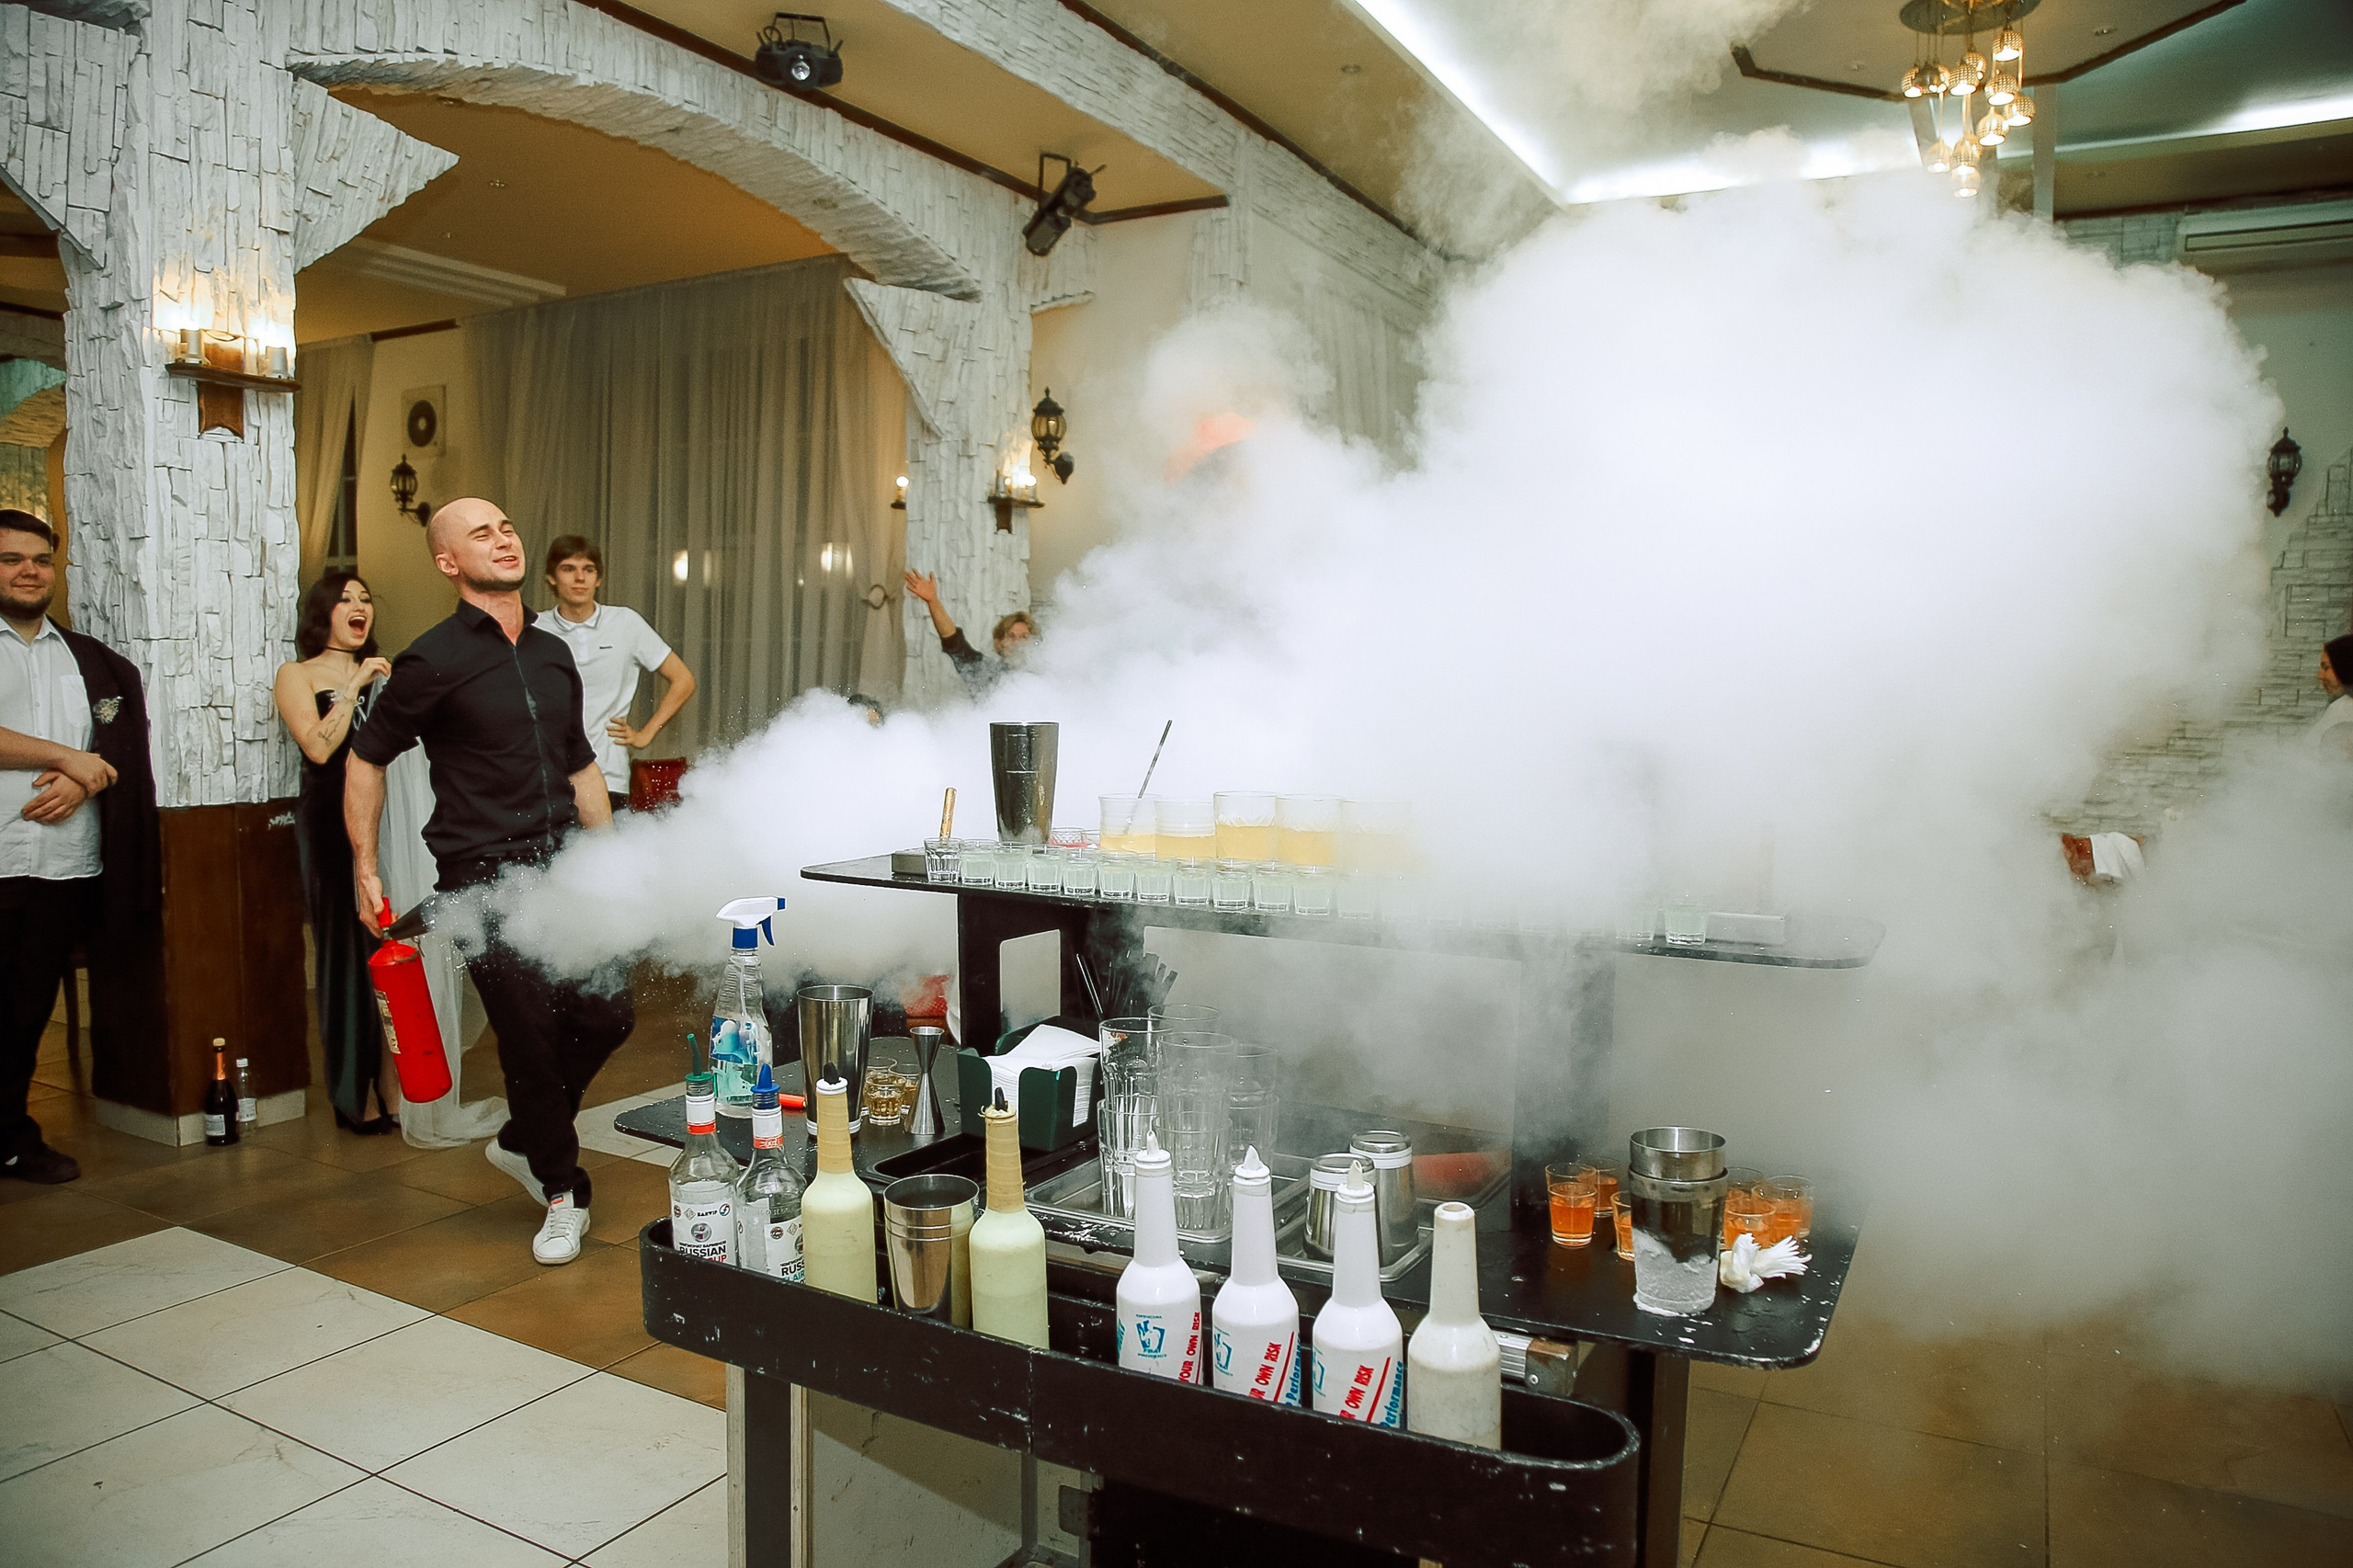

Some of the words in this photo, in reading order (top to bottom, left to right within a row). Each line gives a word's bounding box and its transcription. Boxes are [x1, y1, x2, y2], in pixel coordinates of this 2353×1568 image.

[679, 1245, 726, 1257] RUSSIAN
[1192, 1312, 1201, 1331] RISK
[1186, 1335, 1199, 1356] OWN
[1264, 1342, 1281, 1363] RISK
[1255, 1364, 1275, 1386] OWN
[1354, 1365, 1375, 1387] RISK
[1345, 1386, 1366, 1410] OWN
